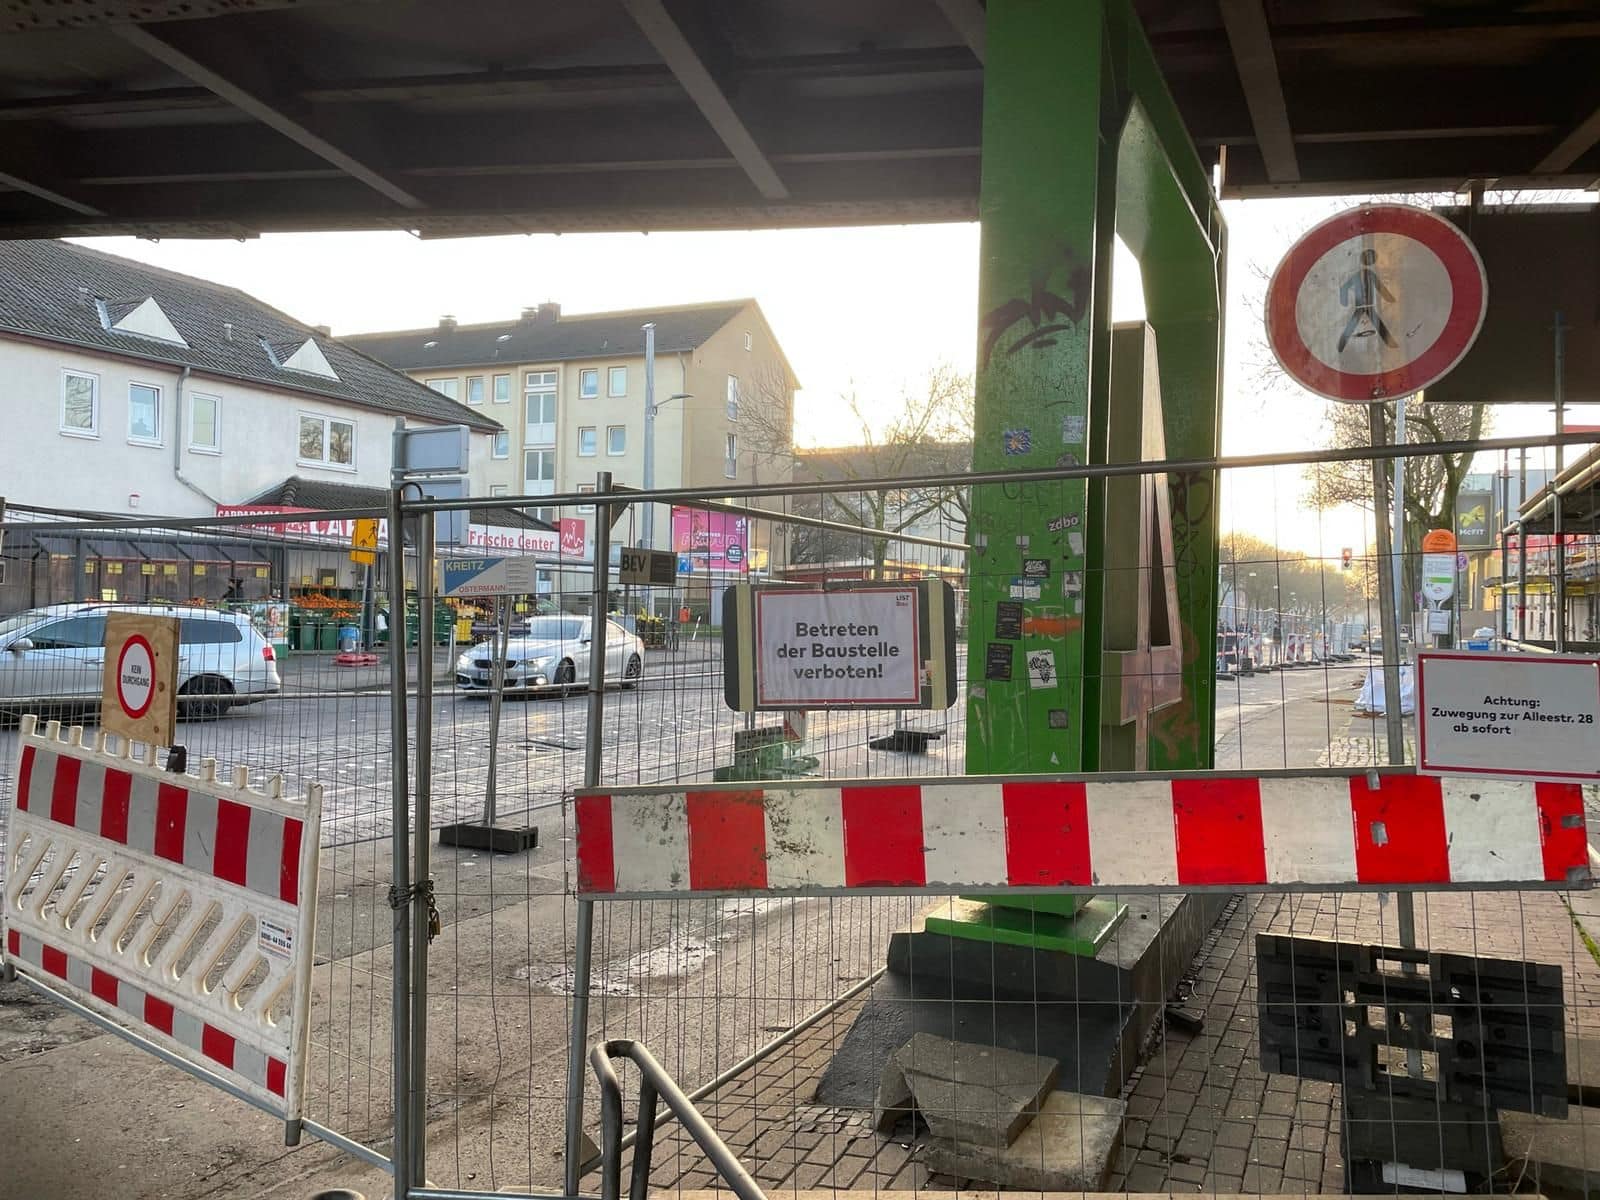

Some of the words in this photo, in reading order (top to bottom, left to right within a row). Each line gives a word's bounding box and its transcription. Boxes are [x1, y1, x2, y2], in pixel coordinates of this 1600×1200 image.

[468, 530, 514, 548] Frische
[518, 534, 555, 551] Center
[445, 560, 485, 572] KREITZ
[622, 554, 647, 572] BEV
[458, 584, 507, 593] OSTERMANN
[795, 622, 879, 637] Betreten
[776, 643, 807, 658] der
[811, 642, 900, 658] Baustelle
[131, 665, 141, 674] KEIN
[793, 664, 883, 679] verboten!
[1483, 695, 1541, 709] Achtung:
[1431, 707, 1497, 721] Zuwegung
[1522, 712, 1575, 723] Alleestr.
[1578, 714, 1593, 724] 28
[1453, 723, 1469, 733] ab
[1472, 724, 1512, 735] sofort
